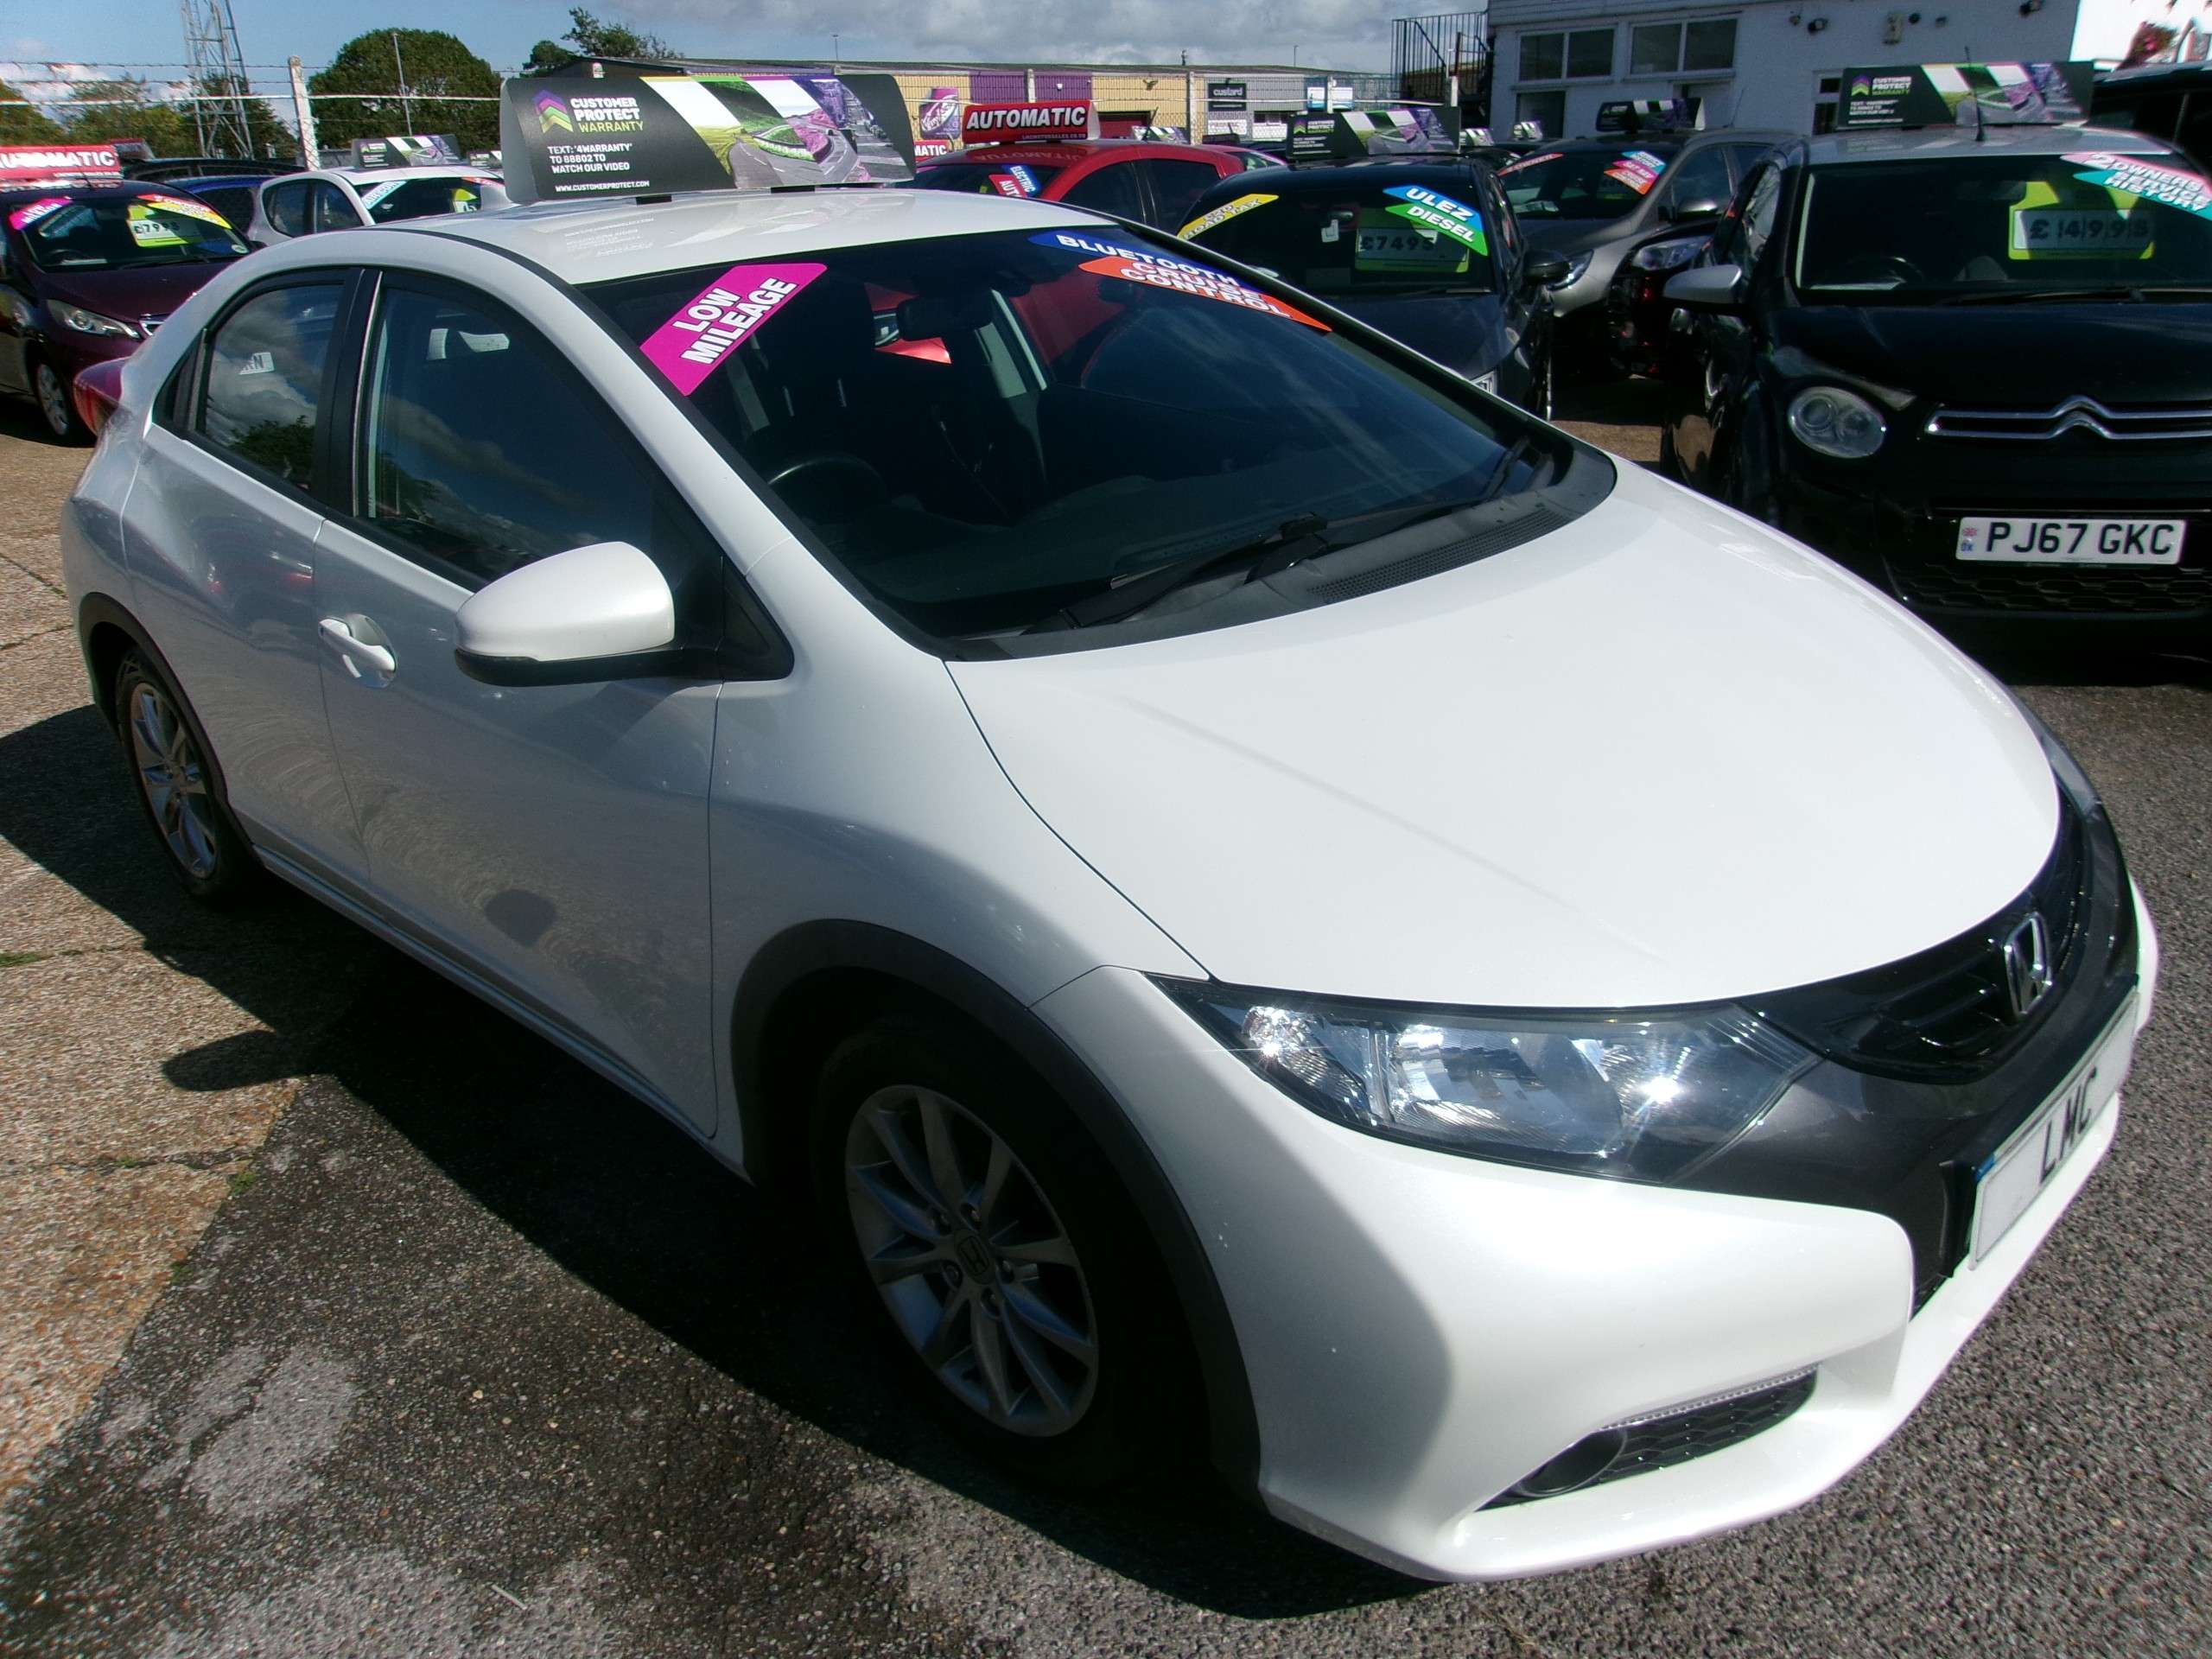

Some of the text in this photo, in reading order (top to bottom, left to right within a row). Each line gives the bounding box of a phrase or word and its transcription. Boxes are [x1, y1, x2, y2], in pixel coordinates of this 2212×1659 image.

[570, 97, 638, 108] CUSTOMER
[1213, 87, 1243, 97] custard
[574, 108, 641, 121] PROTECT
[577, 121, 644, 133] WARRANTY
[966, 106, 1086, 130] AUTOMATIC
[547, 145, 575, 154] TEXT:
[550, 156, 563, 164] TO
[594, 154, 607, 162] TO
[914, 144, 947, 156] MATIC
[551, 162, 630, 174] WATCH OUR VIDEO
[1010, 165, 1036, 193] ELECTRIC
[2082, 153, 2203, 192] 2 OWNERS
[1406, 188, 1473, 222] ULEZ
[2103, 176, 2208, 212] HISTORY
[1407, 206, 1475, 243] DIESEL
[1055, 234, 1239, 287] BLUETOOTH
[1119, 268, 1292, 319] CONTROL
[672, 287, 741, 333] LOW
[680, 277, 798, 365] MILEAGE
[1986, 521, 2175, 556] PJ67 GKC
[2039, 1066, 2097, 1184] LMC
